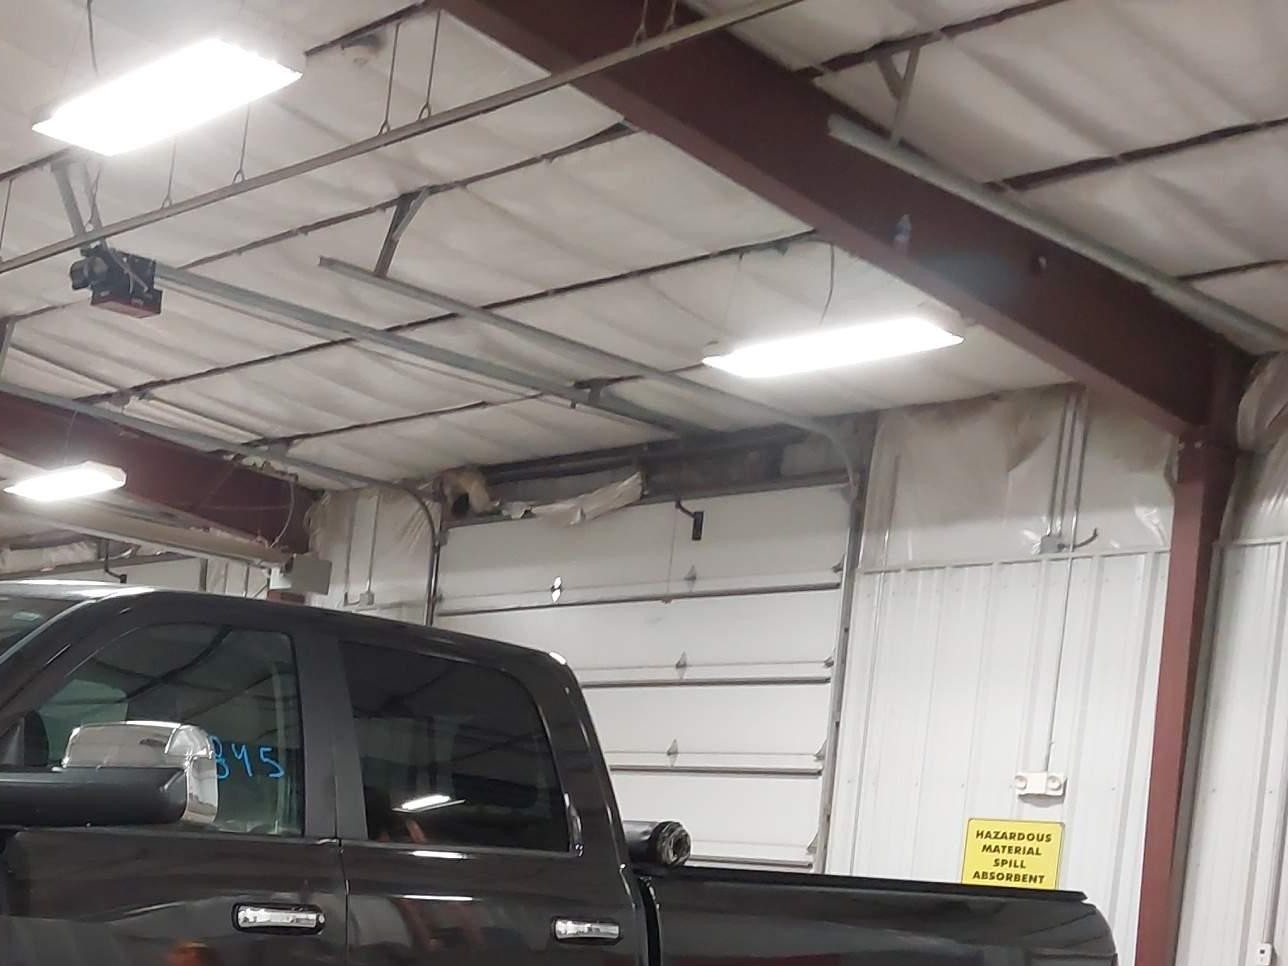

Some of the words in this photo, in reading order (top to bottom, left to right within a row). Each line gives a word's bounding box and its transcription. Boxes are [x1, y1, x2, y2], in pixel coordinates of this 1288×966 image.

[975, 830, 1052, 843] HAZARDOUS
[981, 844, 1042, 856] MATERIAL
[993, 858, 1027, 869] SPILL
[972, 871, 1045, 884] ABSORBENT
